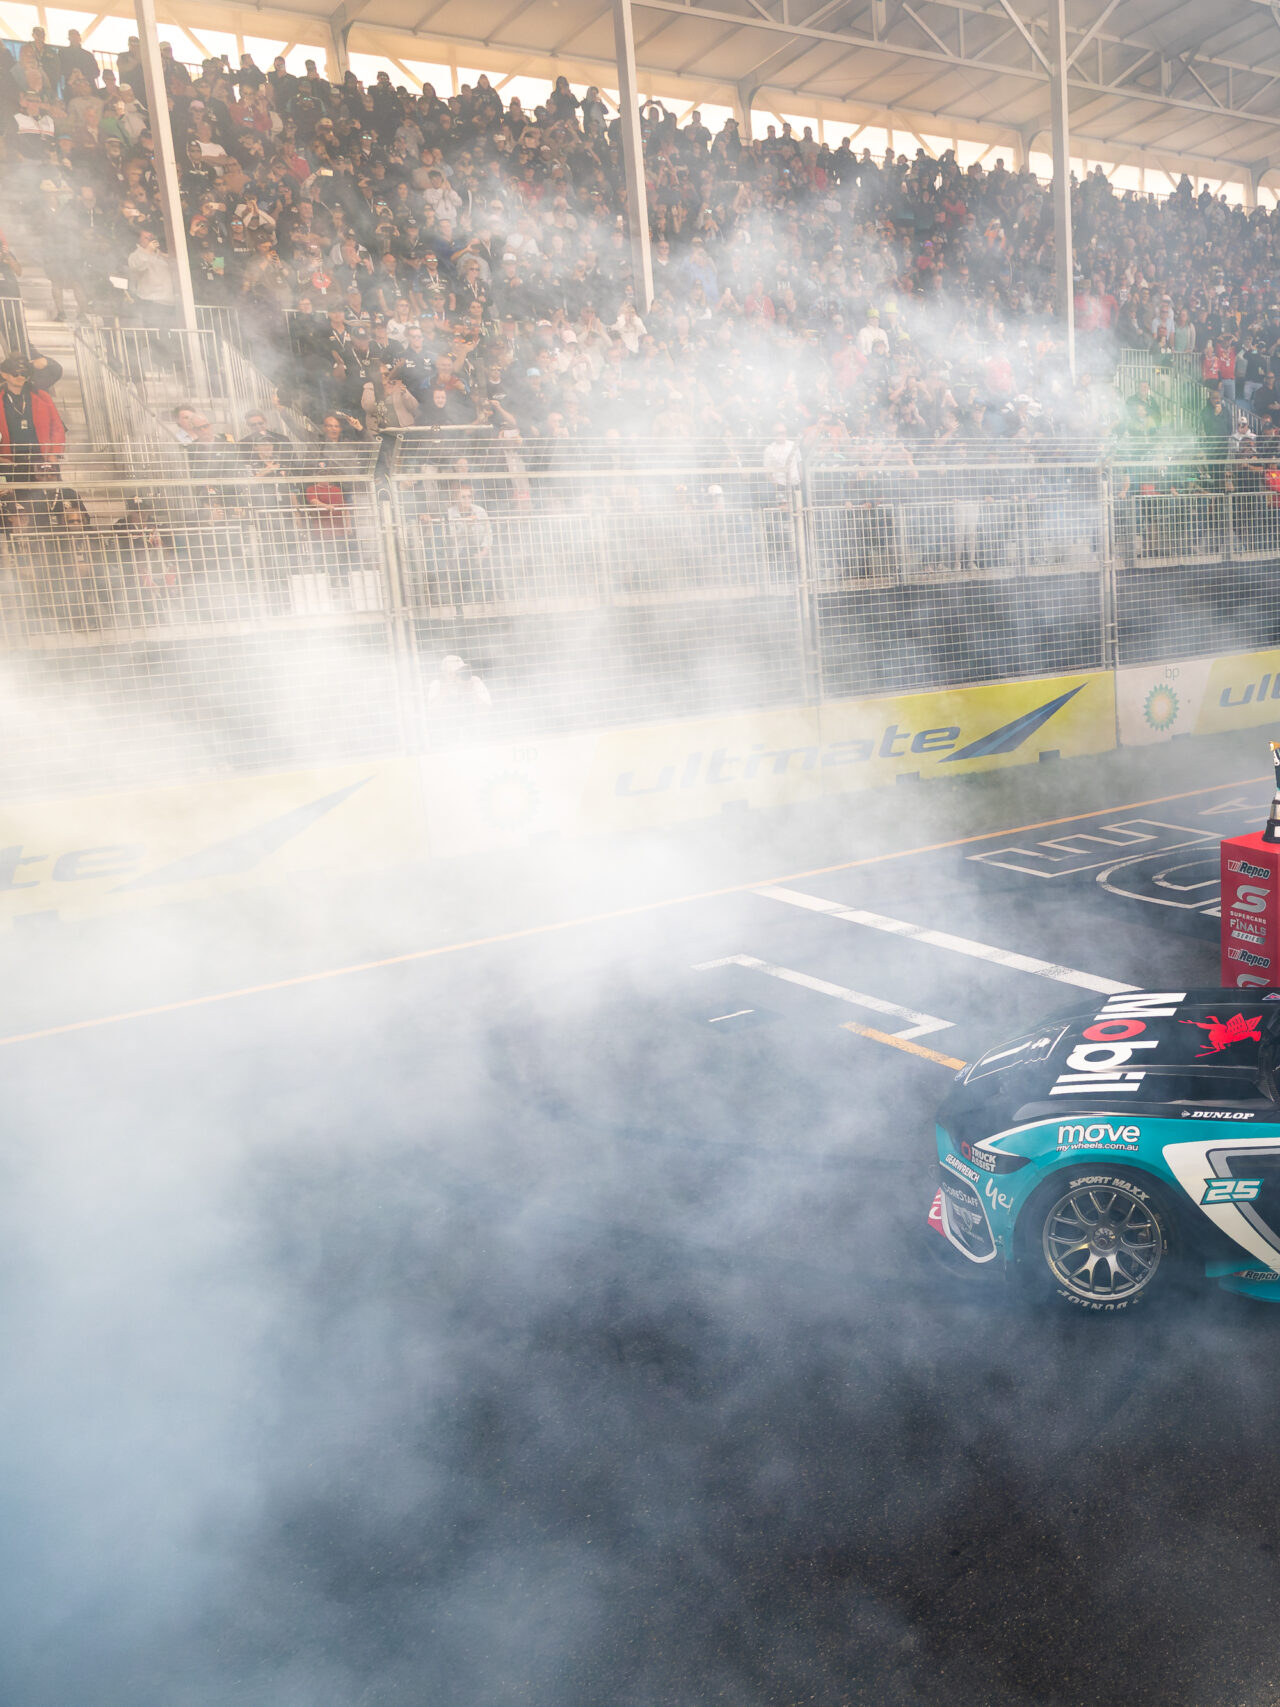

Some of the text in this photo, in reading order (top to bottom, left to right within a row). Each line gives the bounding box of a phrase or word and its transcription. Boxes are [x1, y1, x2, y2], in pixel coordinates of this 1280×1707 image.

[1164, 664, 1180, 682] bp
[614, 725, 961, 797] ultimate
[1239, 860, 1271, 880] Repco
[1230, 910, 1267, 924] SUPERCARS
[1230, 918, 1267, 936] FINALS
[1236, 931, 1260, 943] SERIES
[1239, 949, 1271, 968] Repco
[1049, 993, 1188, 1096] Mobil
[1191, 1110, 1255, 1120] DUNLOP
[1057, 1123, 1141, 1144] move
[971, 1146, 998, 1163] TRUCK
[945, 1153, 981, 1183] GEARWRENCH
[971, 1158, 997, 1173] ASSIST
[1069, 1176, 1151, 1201] SPORT MAXX
[1205, 1180, 1262, 1201] 25
[1245, 1269, 1280, 1281] Repco
